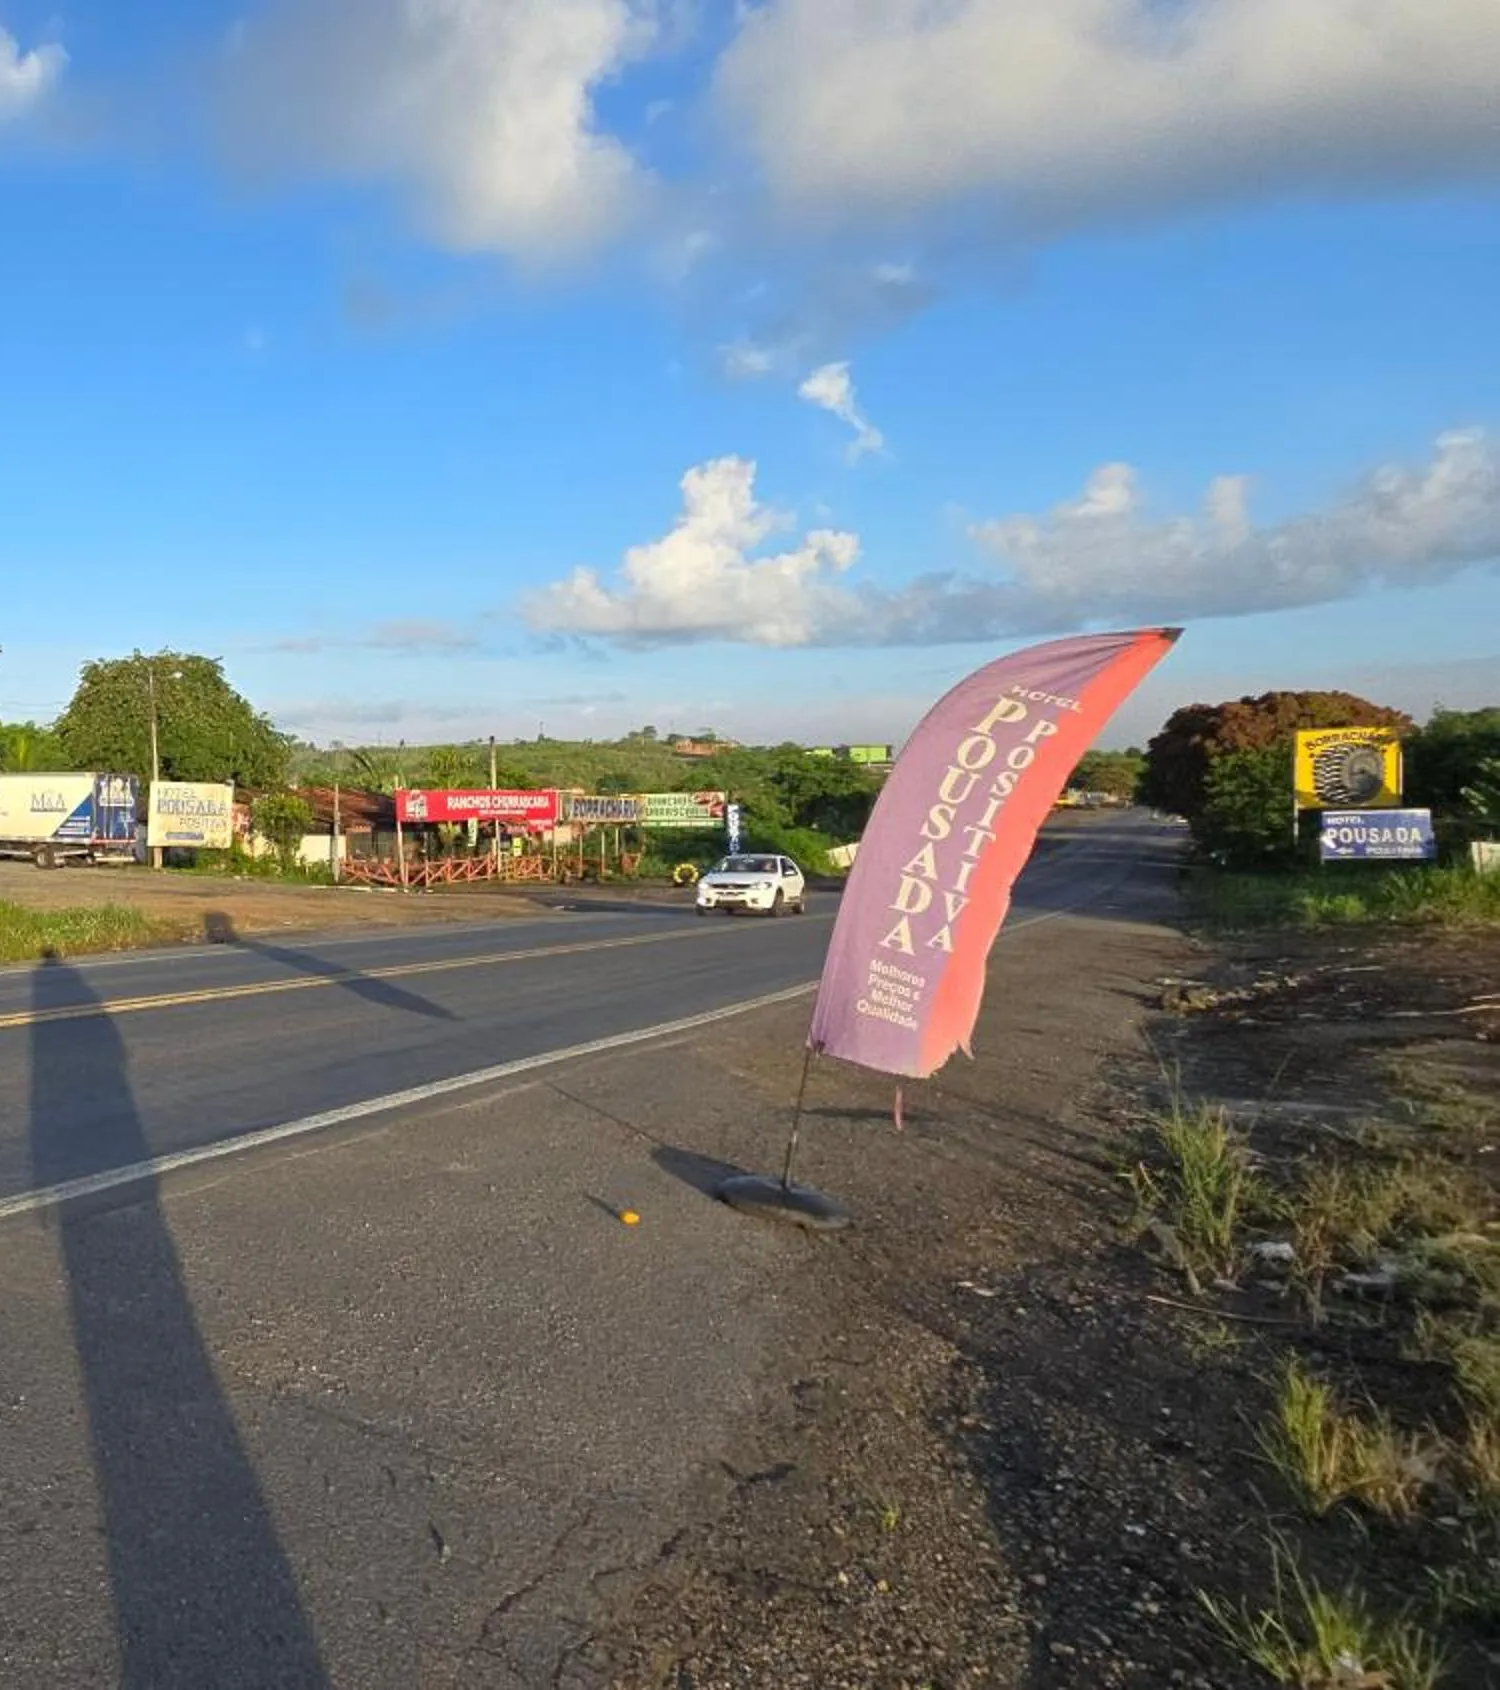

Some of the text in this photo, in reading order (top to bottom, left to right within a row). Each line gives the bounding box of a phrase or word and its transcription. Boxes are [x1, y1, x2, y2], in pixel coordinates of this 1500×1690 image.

[1011, 685, 1083, 713] HOTEL
[877, 694, 1028, 957] POUSADA
[925, 719, 1058, 952] POSITIVA
[1326, 827, 1422, 844] POUSADA
[856, 999, 917, 1031] Qualidade
